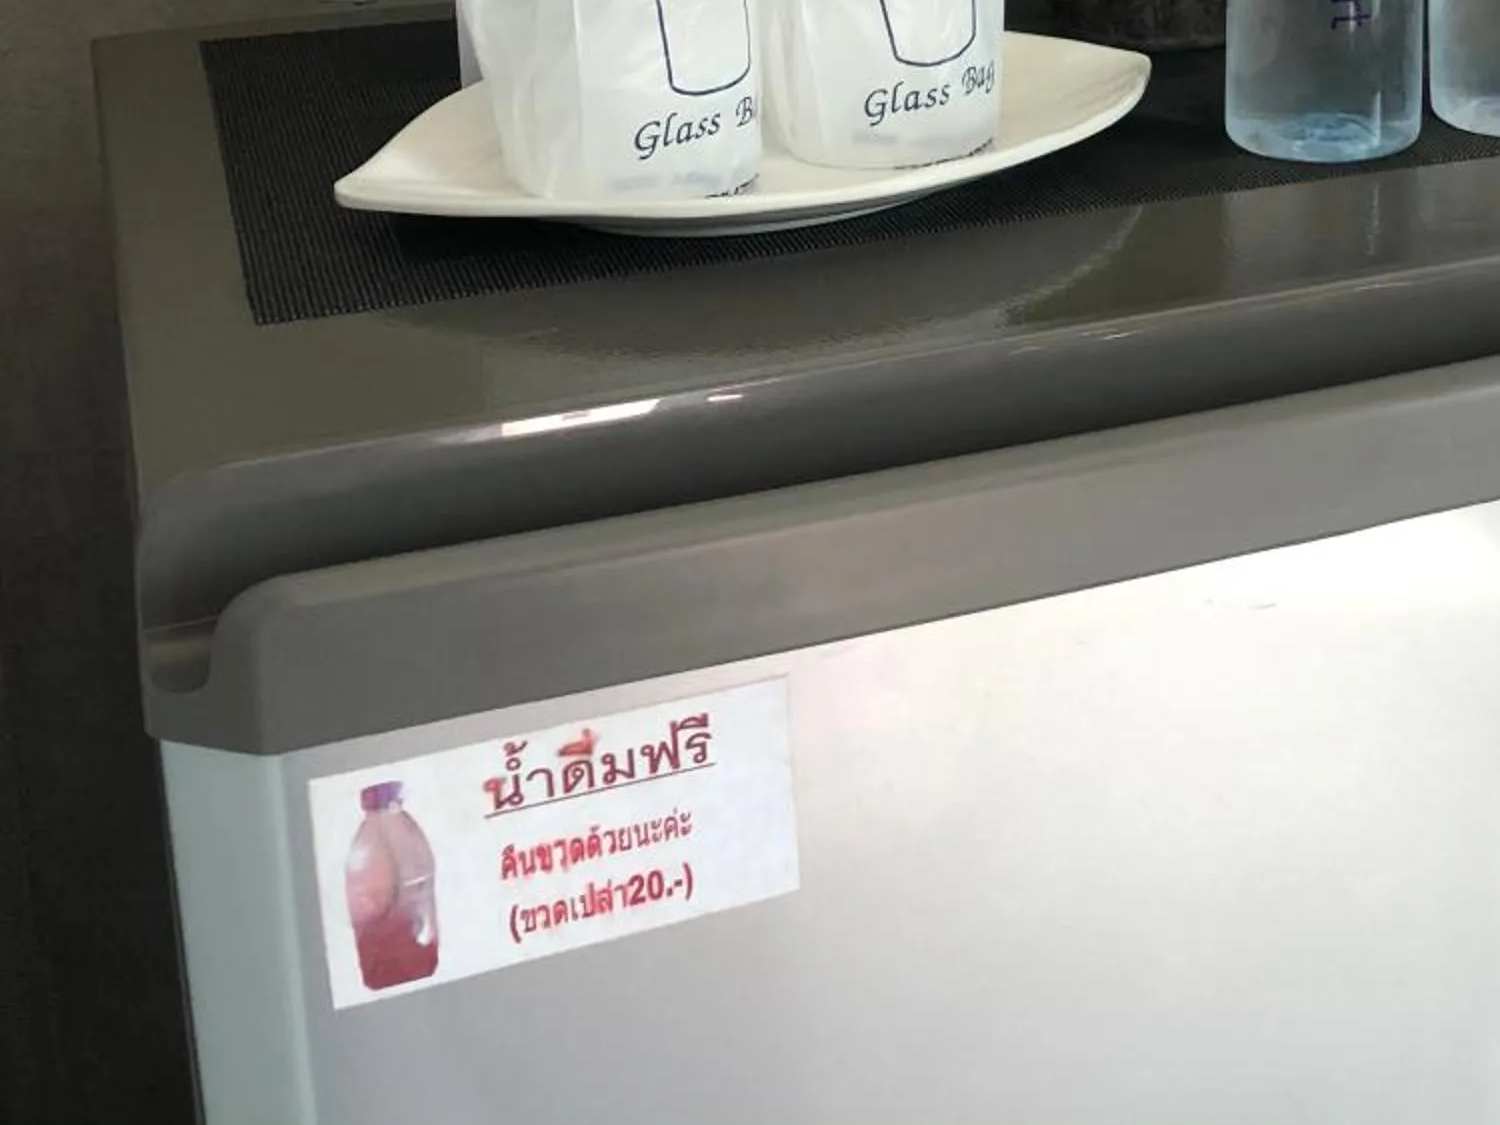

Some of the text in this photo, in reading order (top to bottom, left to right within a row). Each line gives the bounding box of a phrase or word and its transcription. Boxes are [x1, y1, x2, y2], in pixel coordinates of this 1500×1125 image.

[864, 80, 951, 127] Glass
[633, 112, 721, 160] Glass
[482, 713, 715, 811] น้ำดื่มฟรี
[500, 808, 693, 880] คืนขวดด้วยนะค่ะ
